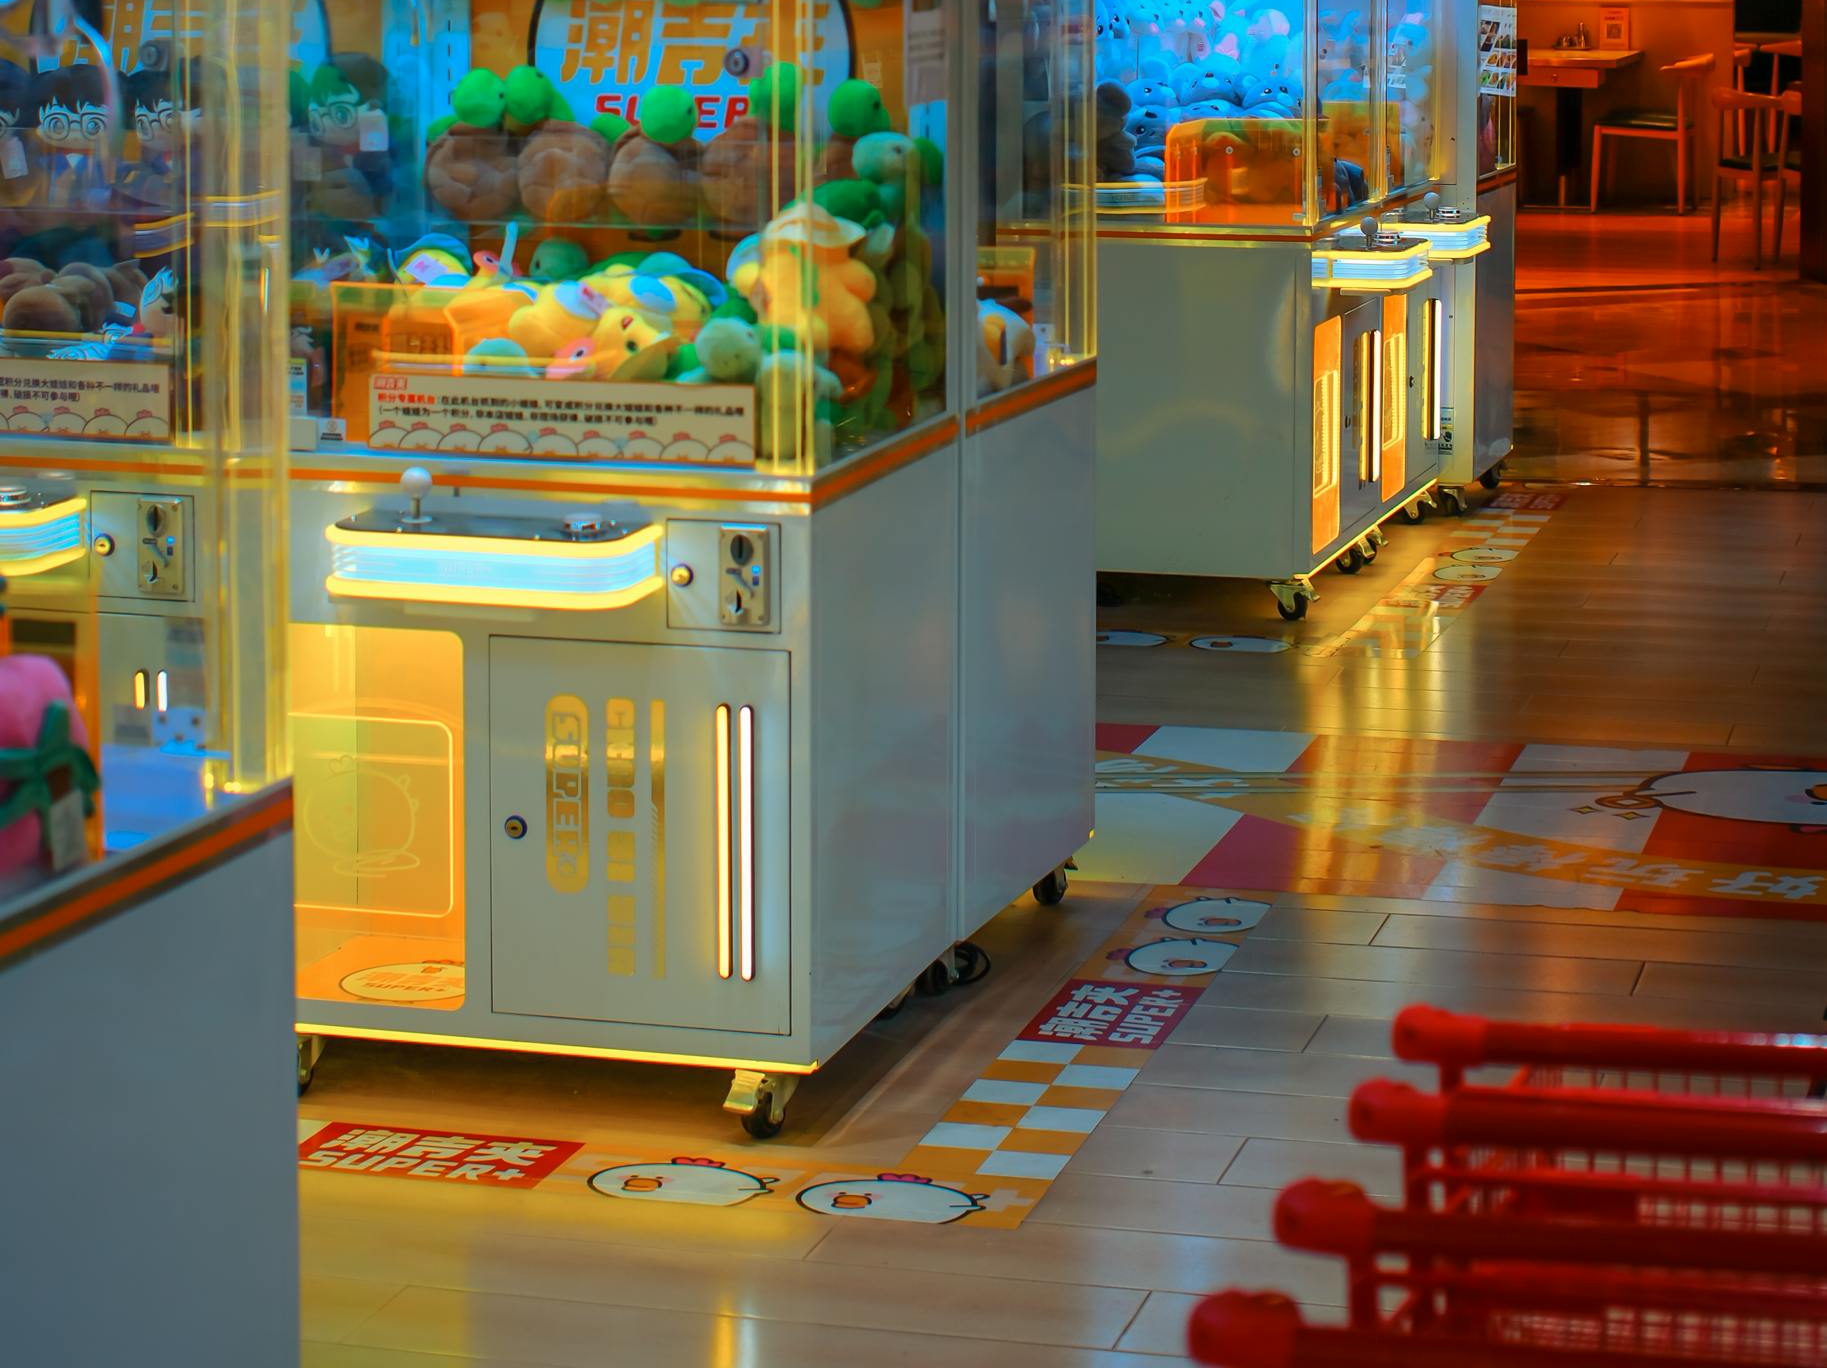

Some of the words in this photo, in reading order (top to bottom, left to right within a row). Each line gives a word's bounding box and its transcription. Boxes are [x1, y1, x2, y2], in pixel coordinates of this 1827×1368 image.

[1038, 983, 1140, 1041] 潮吉夹
[1108, 988, 1184, 1045] SUPER+
[297, 1149, 526, 1181] SUPER+
[319, 1128, 558, 1166] 潮吉夹
